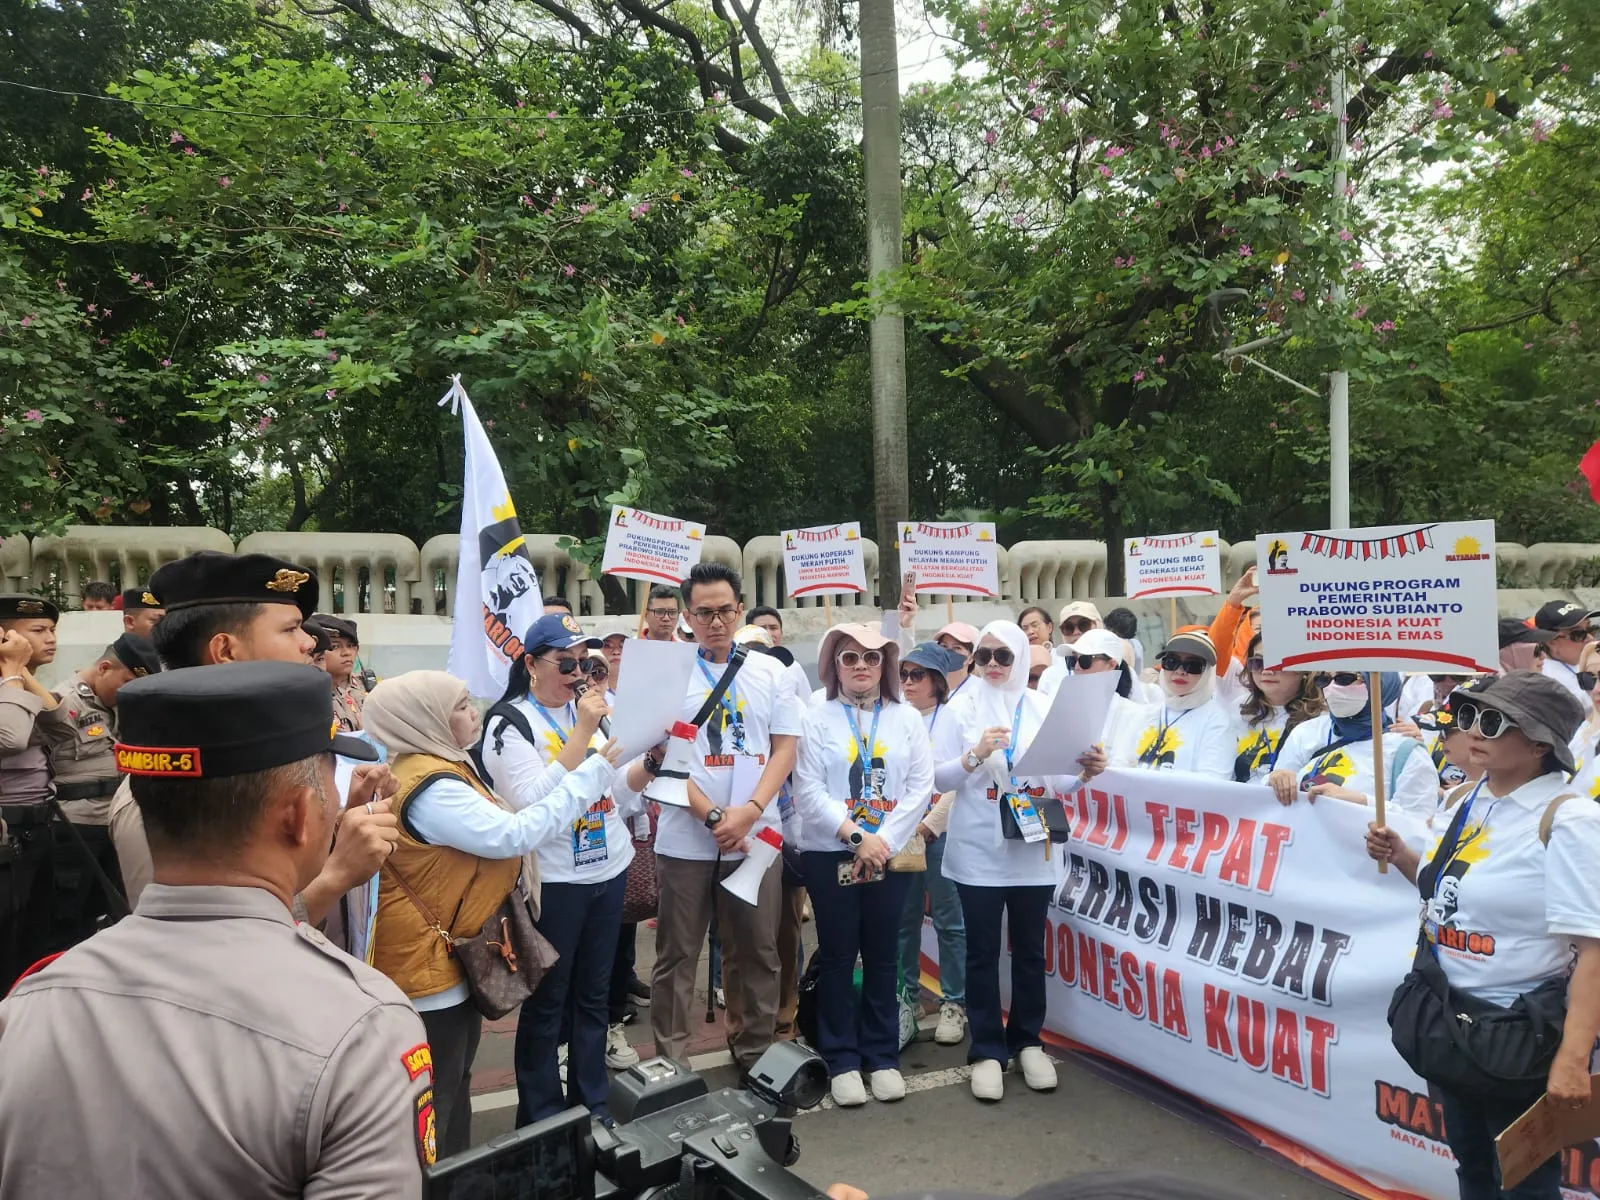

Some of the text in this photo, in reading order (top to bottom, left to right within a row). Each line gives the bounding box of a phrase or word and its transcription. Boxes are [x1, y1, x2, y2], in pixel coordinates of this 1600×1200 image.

[627, 533, 657, 544] DUKUNG
[657, 538, 690, 550] PROGRAM
[619, 543, 689, 561] PRABOWO SUBIANTO
[792, 549, 854, 561] DUKUNG KOPERASI
[624, 557, 660, 568] INDONESIA
[825, 557, 846, 565] PUTIH
[1140, 554, 1204, 566] DUKUNG MBG
[1139, 567, 1178, 575] GENERASI
[1140, 575, 1182, 584] INDONESIA
[1300, 578, 1460, 593] DUKUNG PROGRAM
[1318, 591, 1427, 604] PEMERINTAH
[1287, 603, 1463, 617] PRABOWO SUBIANTO
[1306, 617, 1442, 629] INDONESIA KUAT
[1306, 630, 1443, 641] INDONESIA EMAS
[118, 750, 192, 770] GAMBIR-5
[1144, 801, 1291, 893] TEPAT
[1057, 852, 1350, 1002] ERASI HEBAT
[1467, 932, 1496, 957] 08
[1203, 983, 1335, 1093] KUAT
[1390, 1128, 1426, 1151] MATA
